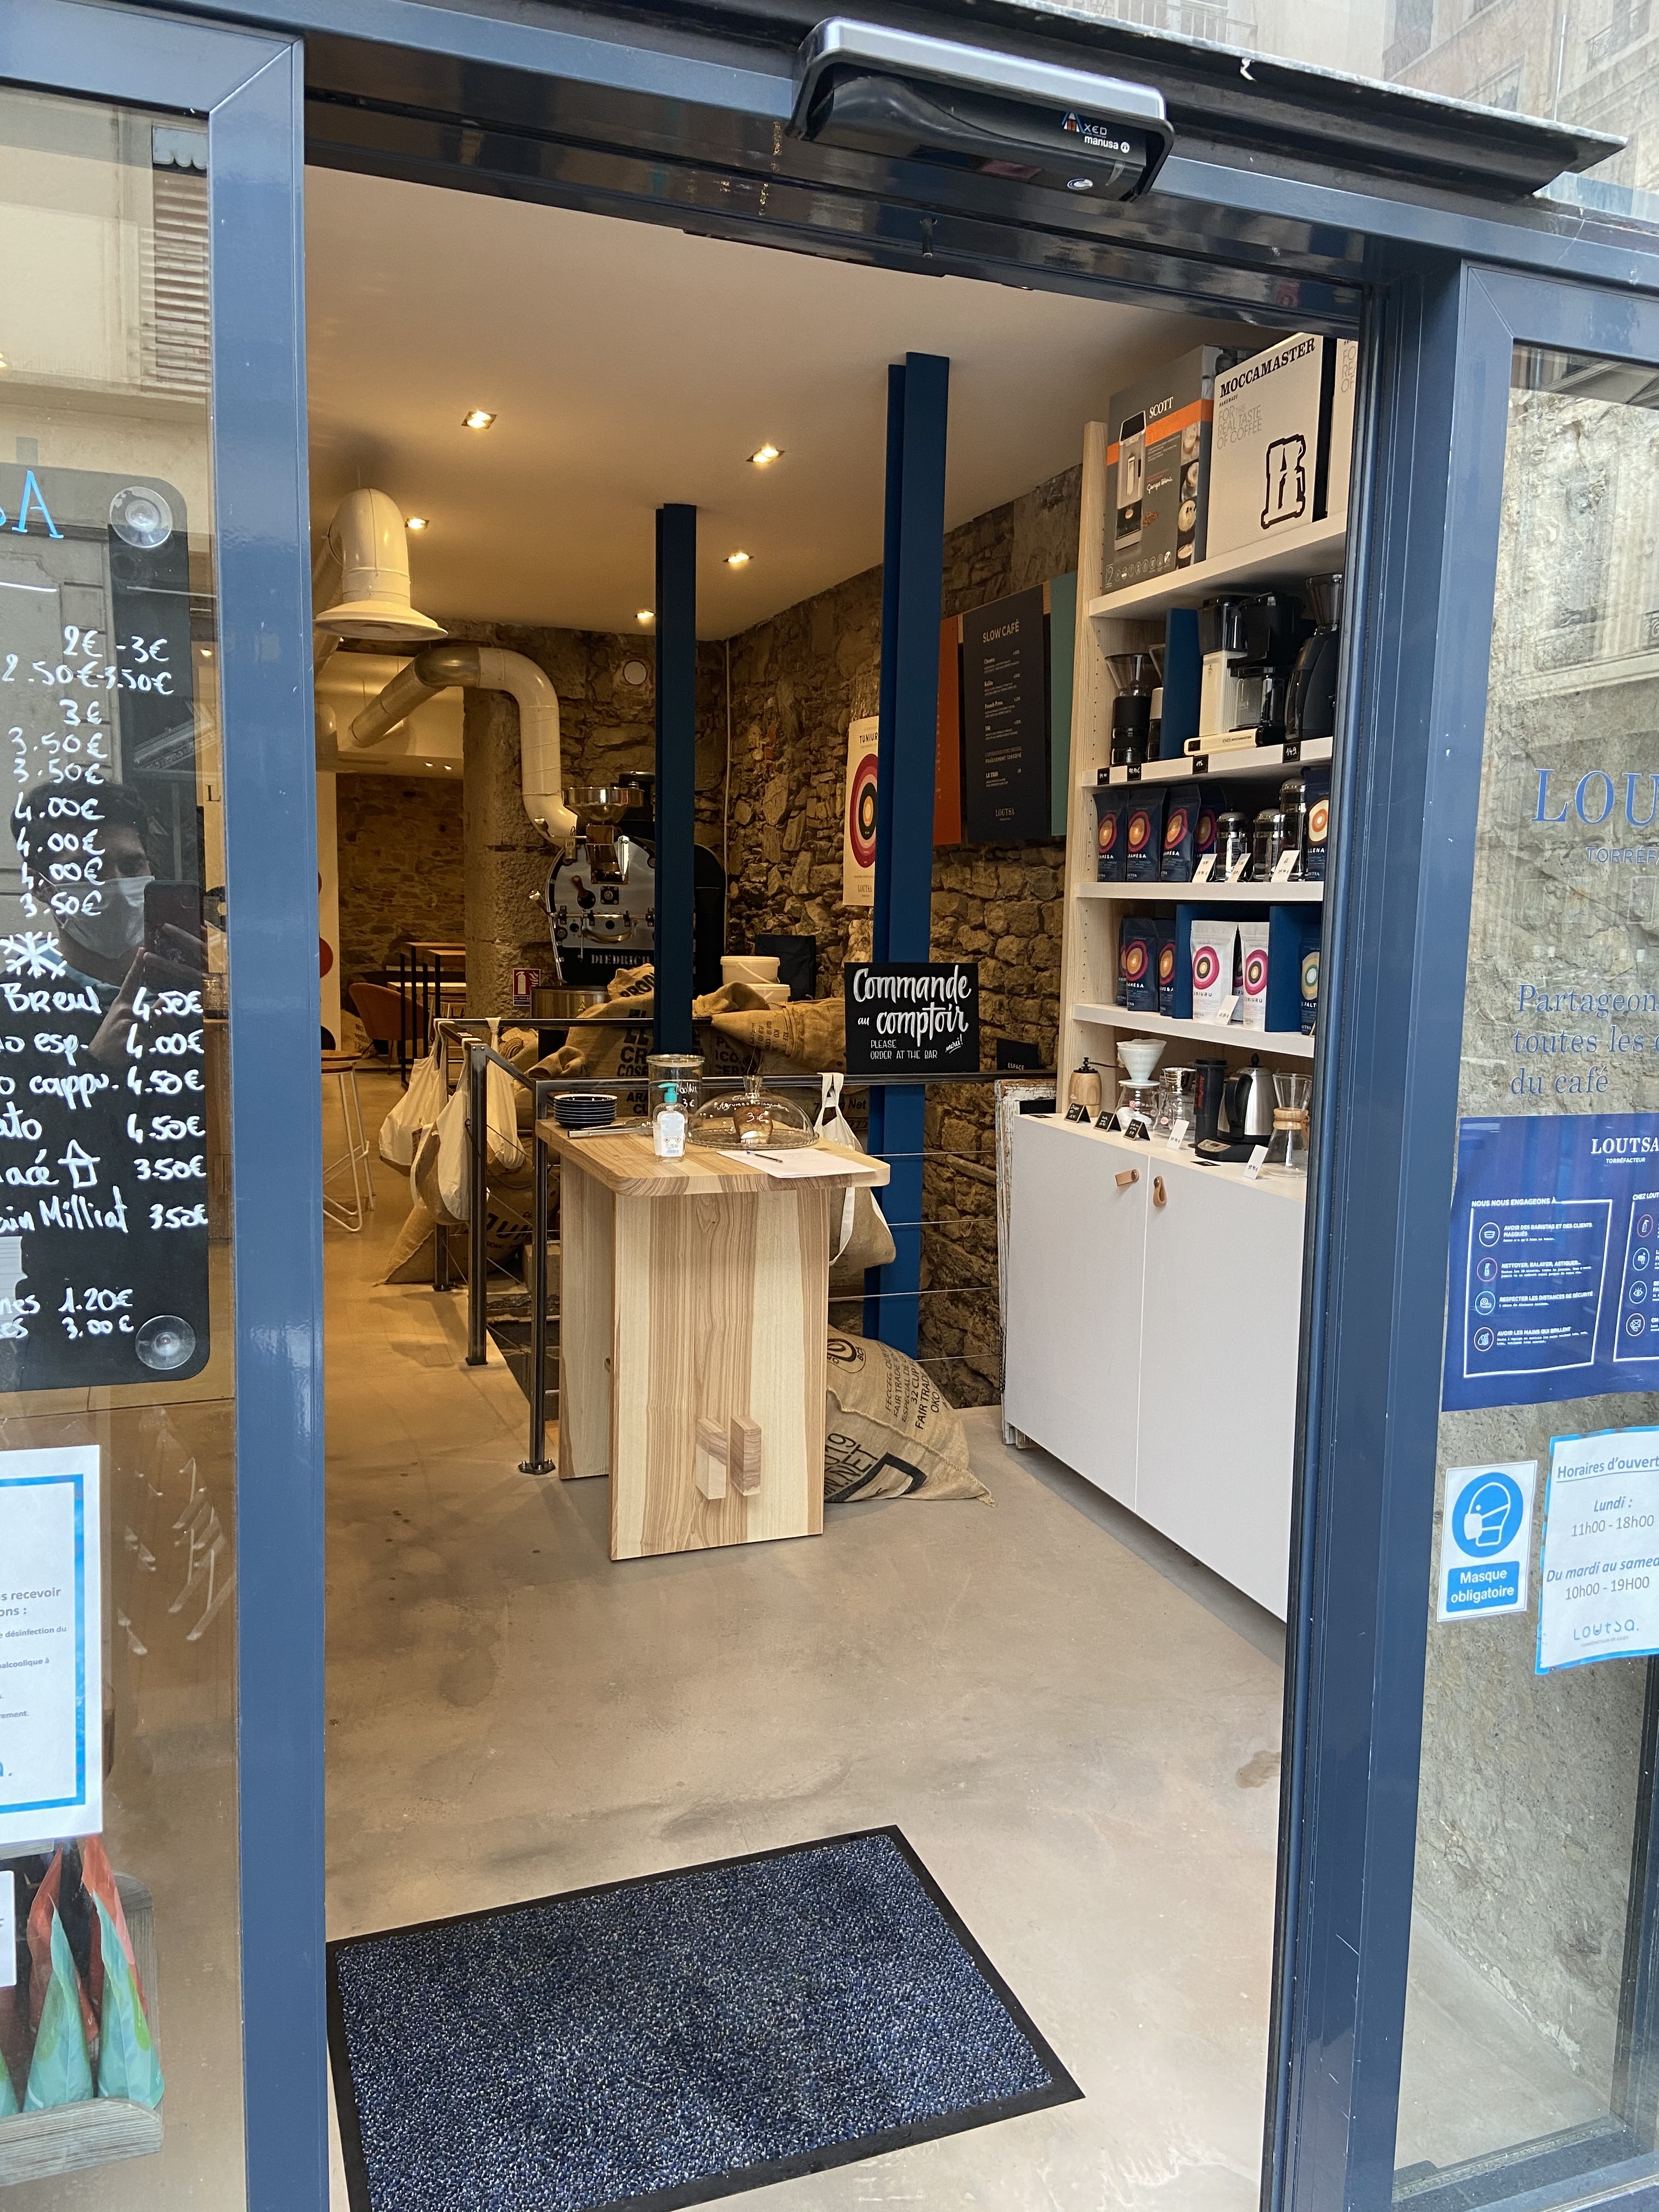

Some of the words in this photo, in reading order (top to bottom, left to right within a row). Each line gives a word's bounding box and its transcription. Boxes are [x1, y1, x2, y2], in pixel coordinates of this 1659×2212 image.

[1084, 136, 1119, 150] manusa
[1220, 337, 1316, 398] MOCCAMASTER
[1149, 396, 1173, 419] SCOTT
[1217, 419, 1236, 437] REAL
[1239, 405, 1261, 427] TASTE
[1218, 405, 1234, 424] FOR
[1217, 434, 1229, 450] OF
[1230, 418, 1262, 443] COFFEE
[64, 626, 103, 657] 2€
[983, 627, 1001, 643] SLOW
[1002, 619, 1020, 636] CAFÉ
[59, 698, 103, 726] 3€
[9, 727, 108, 759] 3.50€
[13, 758, 104, 785] 3.50€
[14, 792, 105, 822] 4.00€
[995, 808, 1015, 817] LOUTSA
[16, 826, 105, 856] 4.00€
[21, 857, 105, 890] 4.00€
[20, 890, 101, 917] 3.50€
[854, 964, 972, 1004] Commande
[132, 988, 203, 1022] 4.50€
[1517, 984, 1657, 1019] Partageon
[858, 1017, 870, 1026] au
[877, 1001, 969, 1047] comptoir
[126, 1023, 205, 1059] 4.00€
[871, 1040, 896, 1048] PLEASE
[1513, 1030, 1597, 1053] toutes
[1608, 1025, 1644, 1053] les
[871, 1050, 891, 1059] ORDER
[896, 1050, 905, 1059] AT
[907, 1050, 920, 1059] THE
[924, 1050, 938, 1059] BAR
[127, 1065, 205, 1094] 4.50€
[1510, 1066, 1542, 1095] du
[1555, 1065, 1609, 1094] café
[849, 1099, 867, 1109] Net
[127, 1114, 206, 1144] 4.50€
[1590, 1137, 1659, 1154] LOUTSA
[0, 1149, 59, 1184] acé
[133, 1155, 206, 1180] 3.50€
[39, 1186, 128, 1233] Milliat
[58, 1287, 133, 1313] 1.20€
[911, 1368, 919, 1389] CUP
[901, 1378, 910, 1423] ESPECIAL
[911, 1391, 918, 1404] 32
[915, 1403, 928, 1429] FAIR
[1558, 1462, 1605, 1479] Horaires
[1594, 1496, 1626, 1512] Lundi
[1571, 1521, 1606, 1537] 11h00
[1616, 1515, 1655, 1530] 18h00
[1459, 1570, 1508, 1587] Masque
[1547, 1570, 1562, 1583] Du
[1565, 1562, 1599, 1579] mardi
[1602, 1562, 1616, 1573] au
[11, 1587, 61, 1600] recevoir
[1451, 1585, 1515, 1604] obligatoire
[1565, 1582, 1600, 1601] 10h00
[1611, 1576, 1650, 1592] 19H00
[5, 1628, 54, 1638] désinfection
